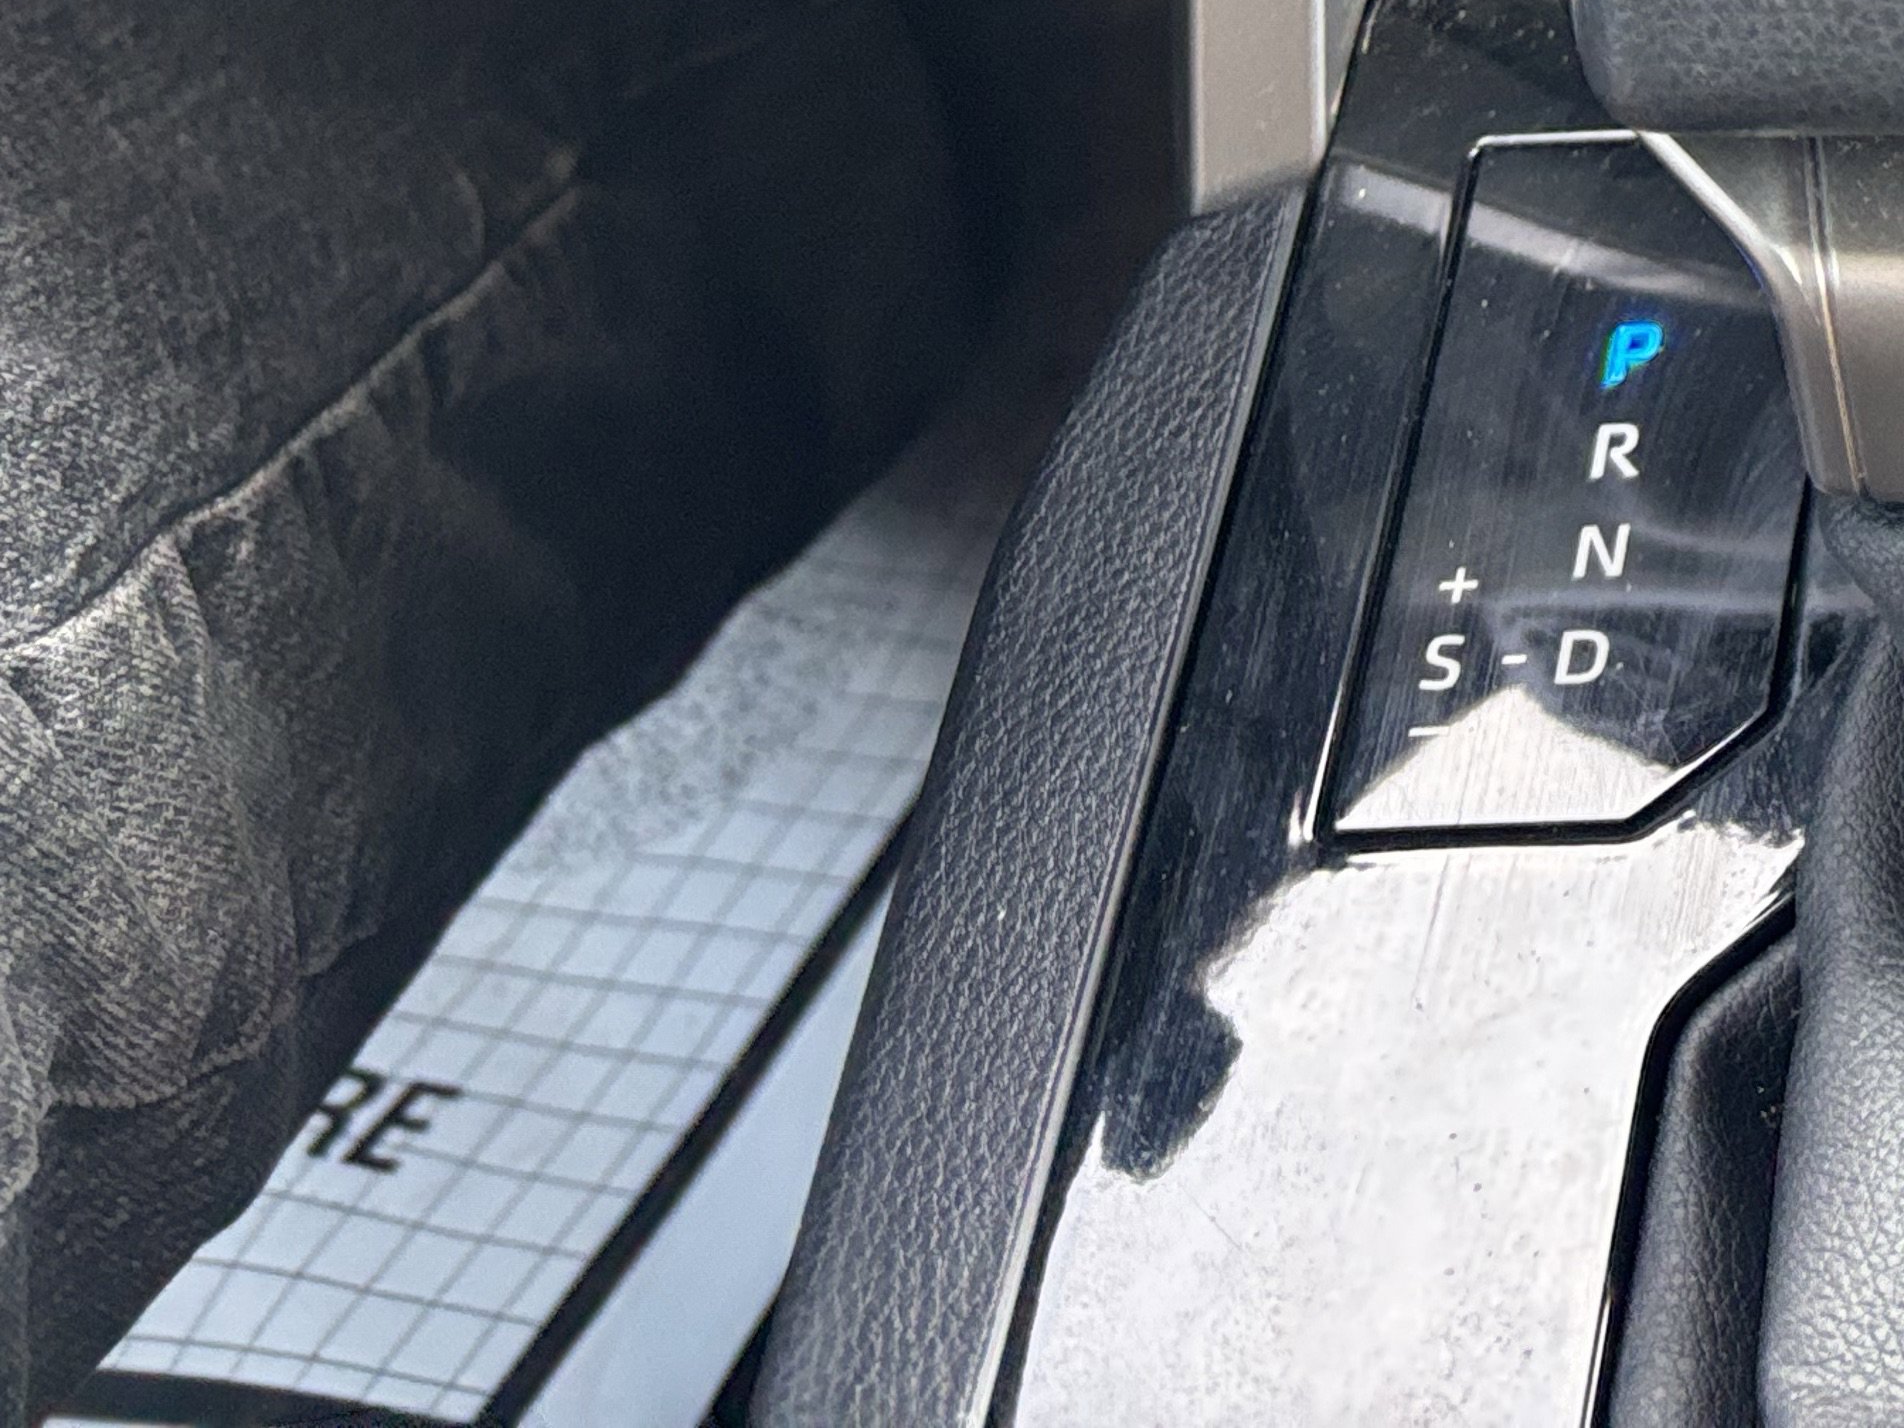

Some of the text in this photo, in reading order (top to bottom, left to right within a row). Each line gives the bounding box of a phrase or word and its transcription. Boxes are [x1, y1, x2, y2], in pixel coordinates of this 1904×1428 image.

[1602, 319, 1664, 389] P
[1588, 421, 1641, 480] R
[1571, 523, 1632, 580] N
[1417, 628, 1611, 692] S D
